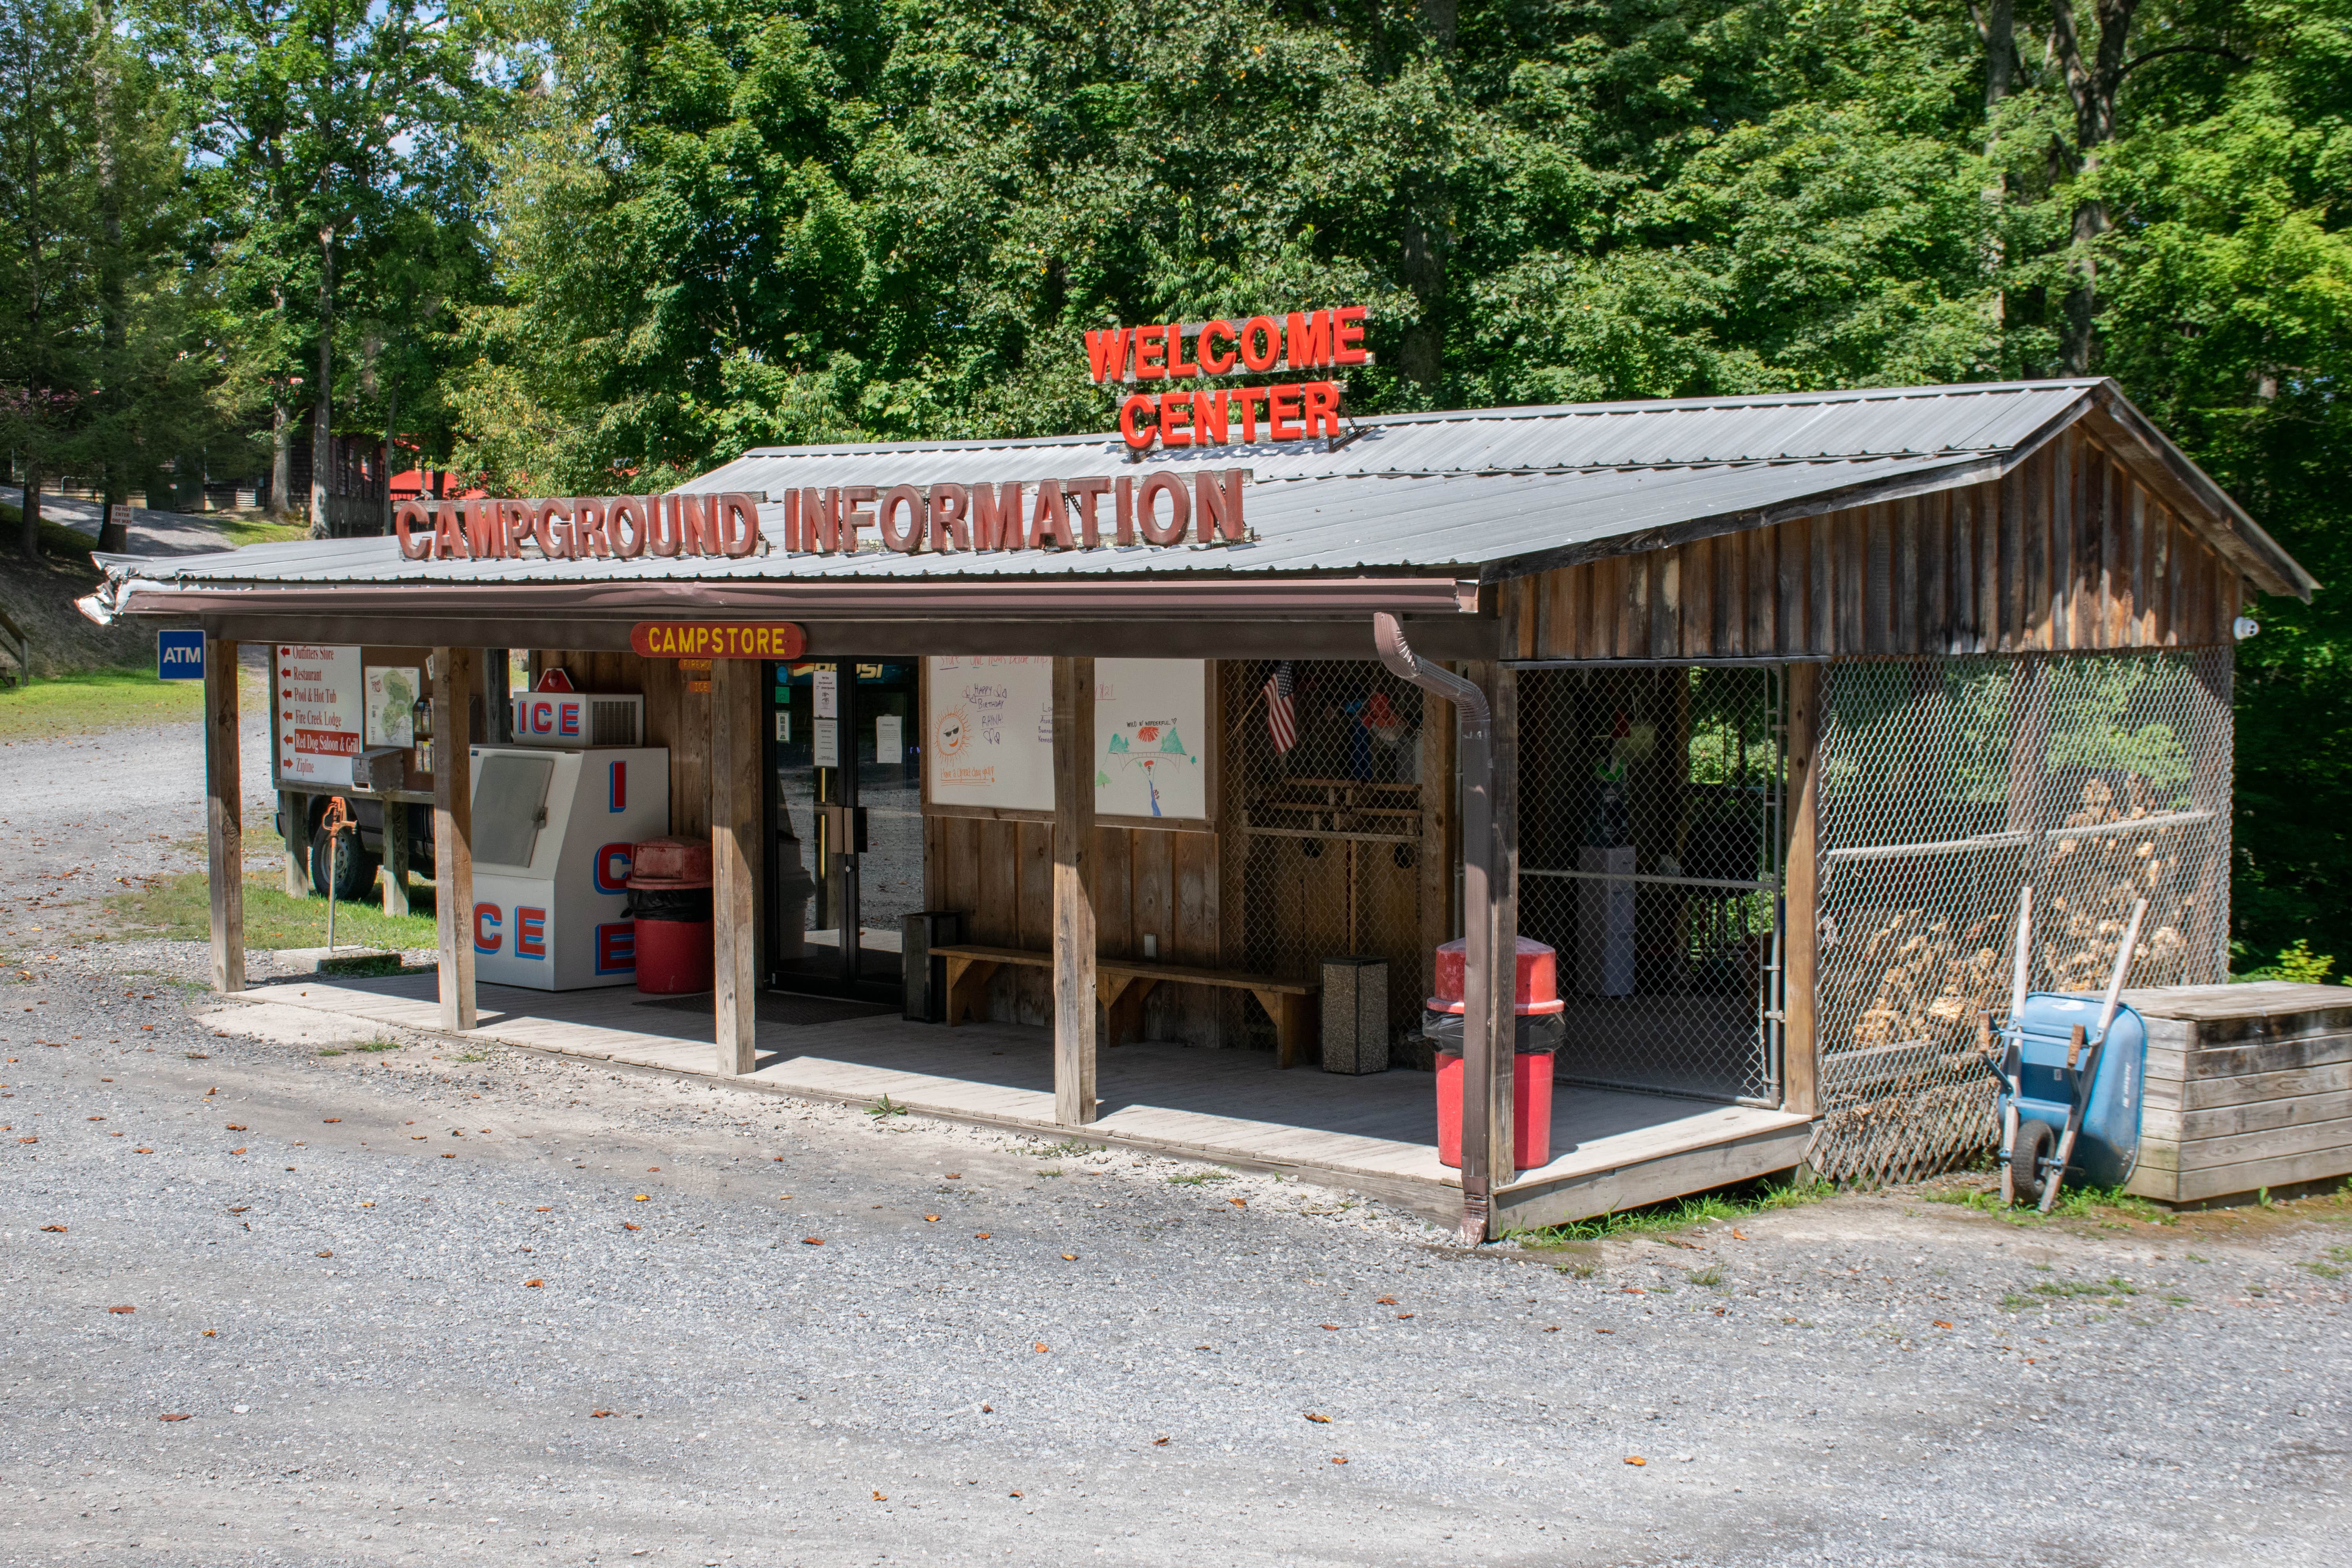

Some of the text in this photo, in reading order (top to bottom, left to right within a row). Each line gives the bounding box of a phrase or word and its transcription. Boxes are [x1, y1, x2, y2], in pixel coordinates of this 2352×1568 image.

[1085, 306, 1367, 383] WELCOME
[1120, 381, 1339, 448] CENTER
[396, 468, 1243, 560] CAMPGROUND INFORMATION
[648, 627, 784, 654] CAMPSTORE
[163, 647, 201, 663] ATM
[293, 646, 334, 660] Outfitters Store
[294, 666, 321, 681] Restaurant
[295, 688, 336, 703] Pool & Hot Tub
[695, 682, 707, 691] ICE
[975, 684, 992, 696] HAPPY
[296, 710, 341, 730] Fire Creek Lodge
[518, 701, 579, 736] ICE
[296, 734, 358, 753] Red Dog Saloon & Grill
[296, 758, 314, 776] Zipline
[941, 768, 951, 778] Have
[953, 769, 956, 777] a
[972, 767, 981, 780] day
[473, 902, 546, 960] CE
